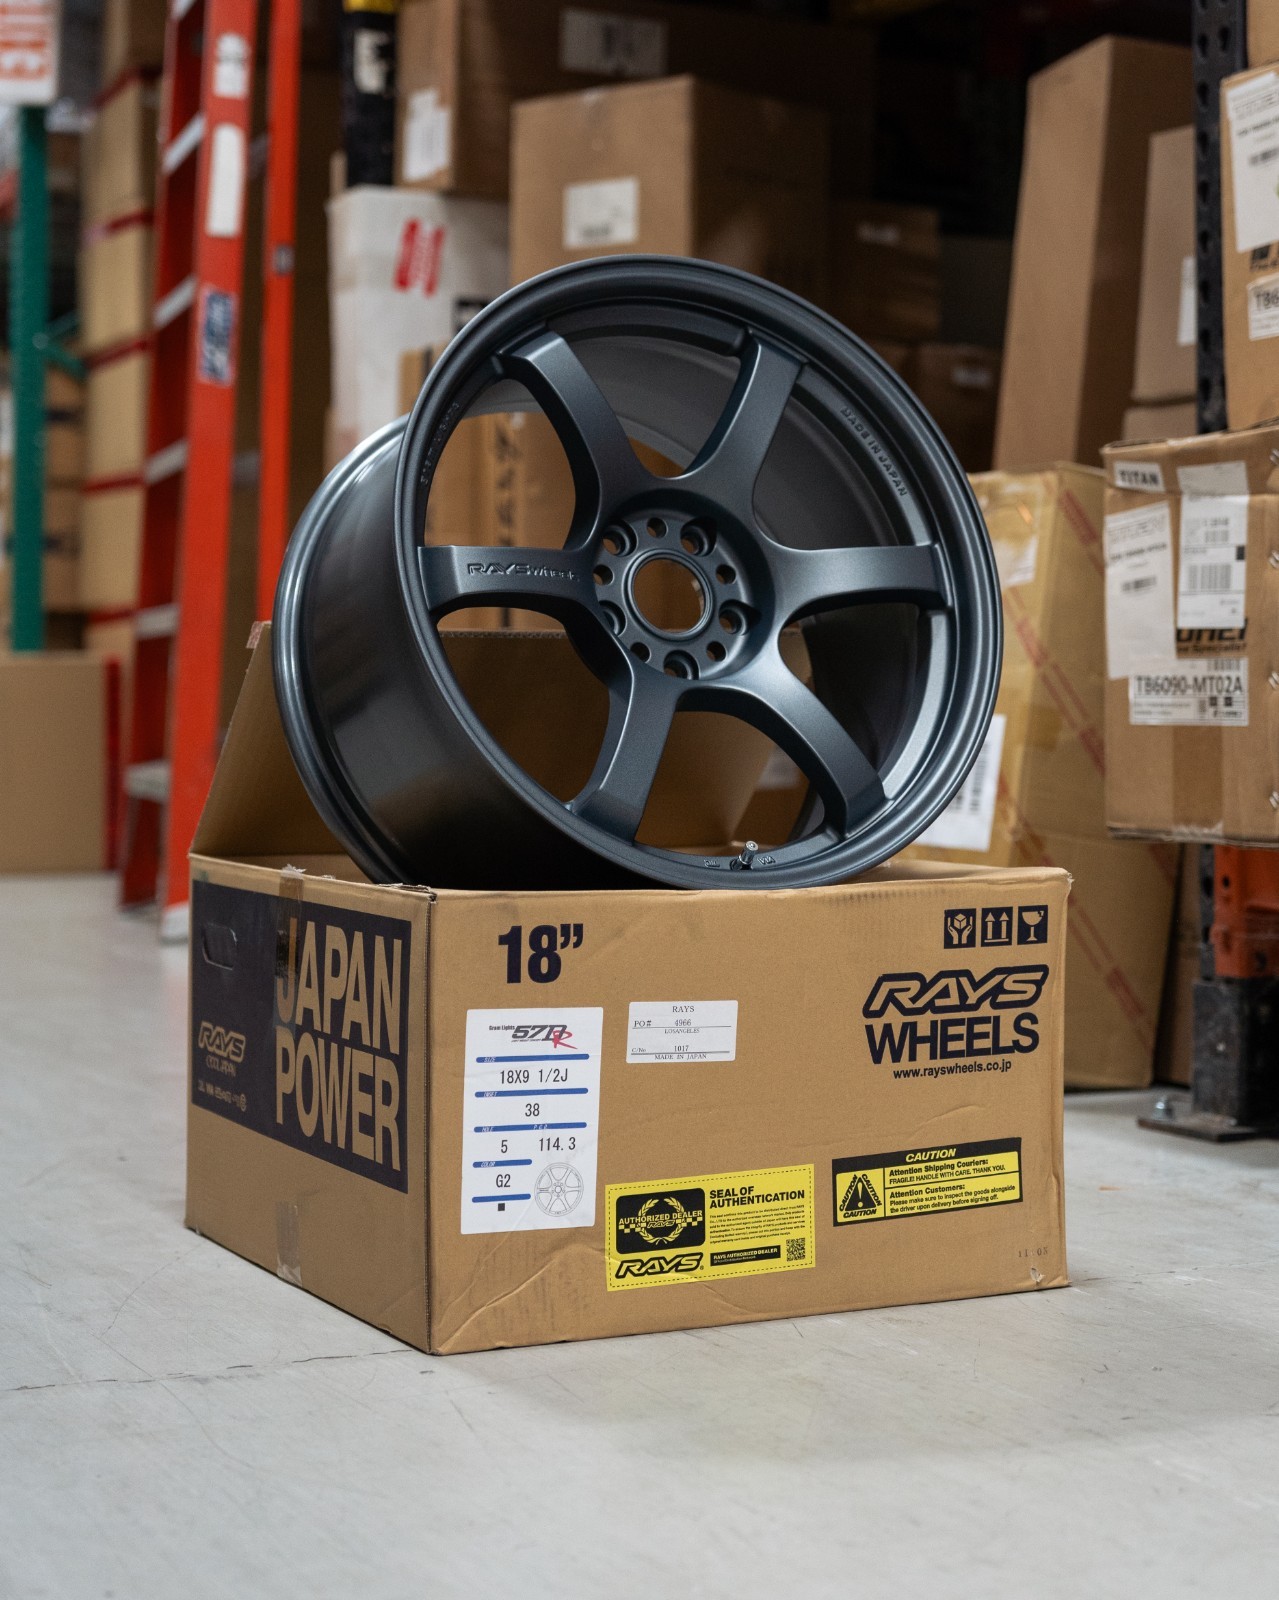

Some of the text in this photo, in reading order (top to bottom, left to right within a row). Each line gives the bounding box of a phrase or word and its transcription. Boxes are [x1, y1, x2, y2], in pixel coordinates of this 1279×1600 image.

[841, 406, 908, 497] MADE IN JAPAN
[276, 917, 403, 1055] JAPAN
[862, 964, 1050, 1019] RAYS
[672, 1005, 695, 1013] RAYS
[674, 1018, 692, 1027] 4966
[198, 1020, 247, 1064] RAYS
[864, 1012, 1040, 1064] WHEELS
[673, 1044, 690, 1052] 1017
[500, 1068, 568, 1084] 18X9 1/2J
[893, 1059, 1013, 1079] www.rayswheels.co.jp
[275, 1026, 402, 1172] POWER
[524, 1102, 540, 1117] 38
[500, 1139, 508, 1153] 5
[905, 1148, 957, 1162] CAUTION
[889, 1159, 989, 1177] Attention Shipping Couriers:
[915, 1173, 939, 1182] HANDLE
[973, 1166, 992, 1174] THANK
[495, 1174, 511, 1188] G2
[709, 1186, 755, 1200] SEAL OF
[839, 1173, 858, 1212] CAUTION
[861, 1173, 882, 1207] CAUTION
[889, 1184, 966, 1199] Attention Customers:
[709, 1190, 805, 1209] AUTHENTICATION
[916, 1203, 931, 1211] upon
[618, 1210, 704, 1225] AUTHORIZED DEALER
[843, 1208, 877, 1218] CAUTION
[615, 1252, 703, 1279] RAYS
